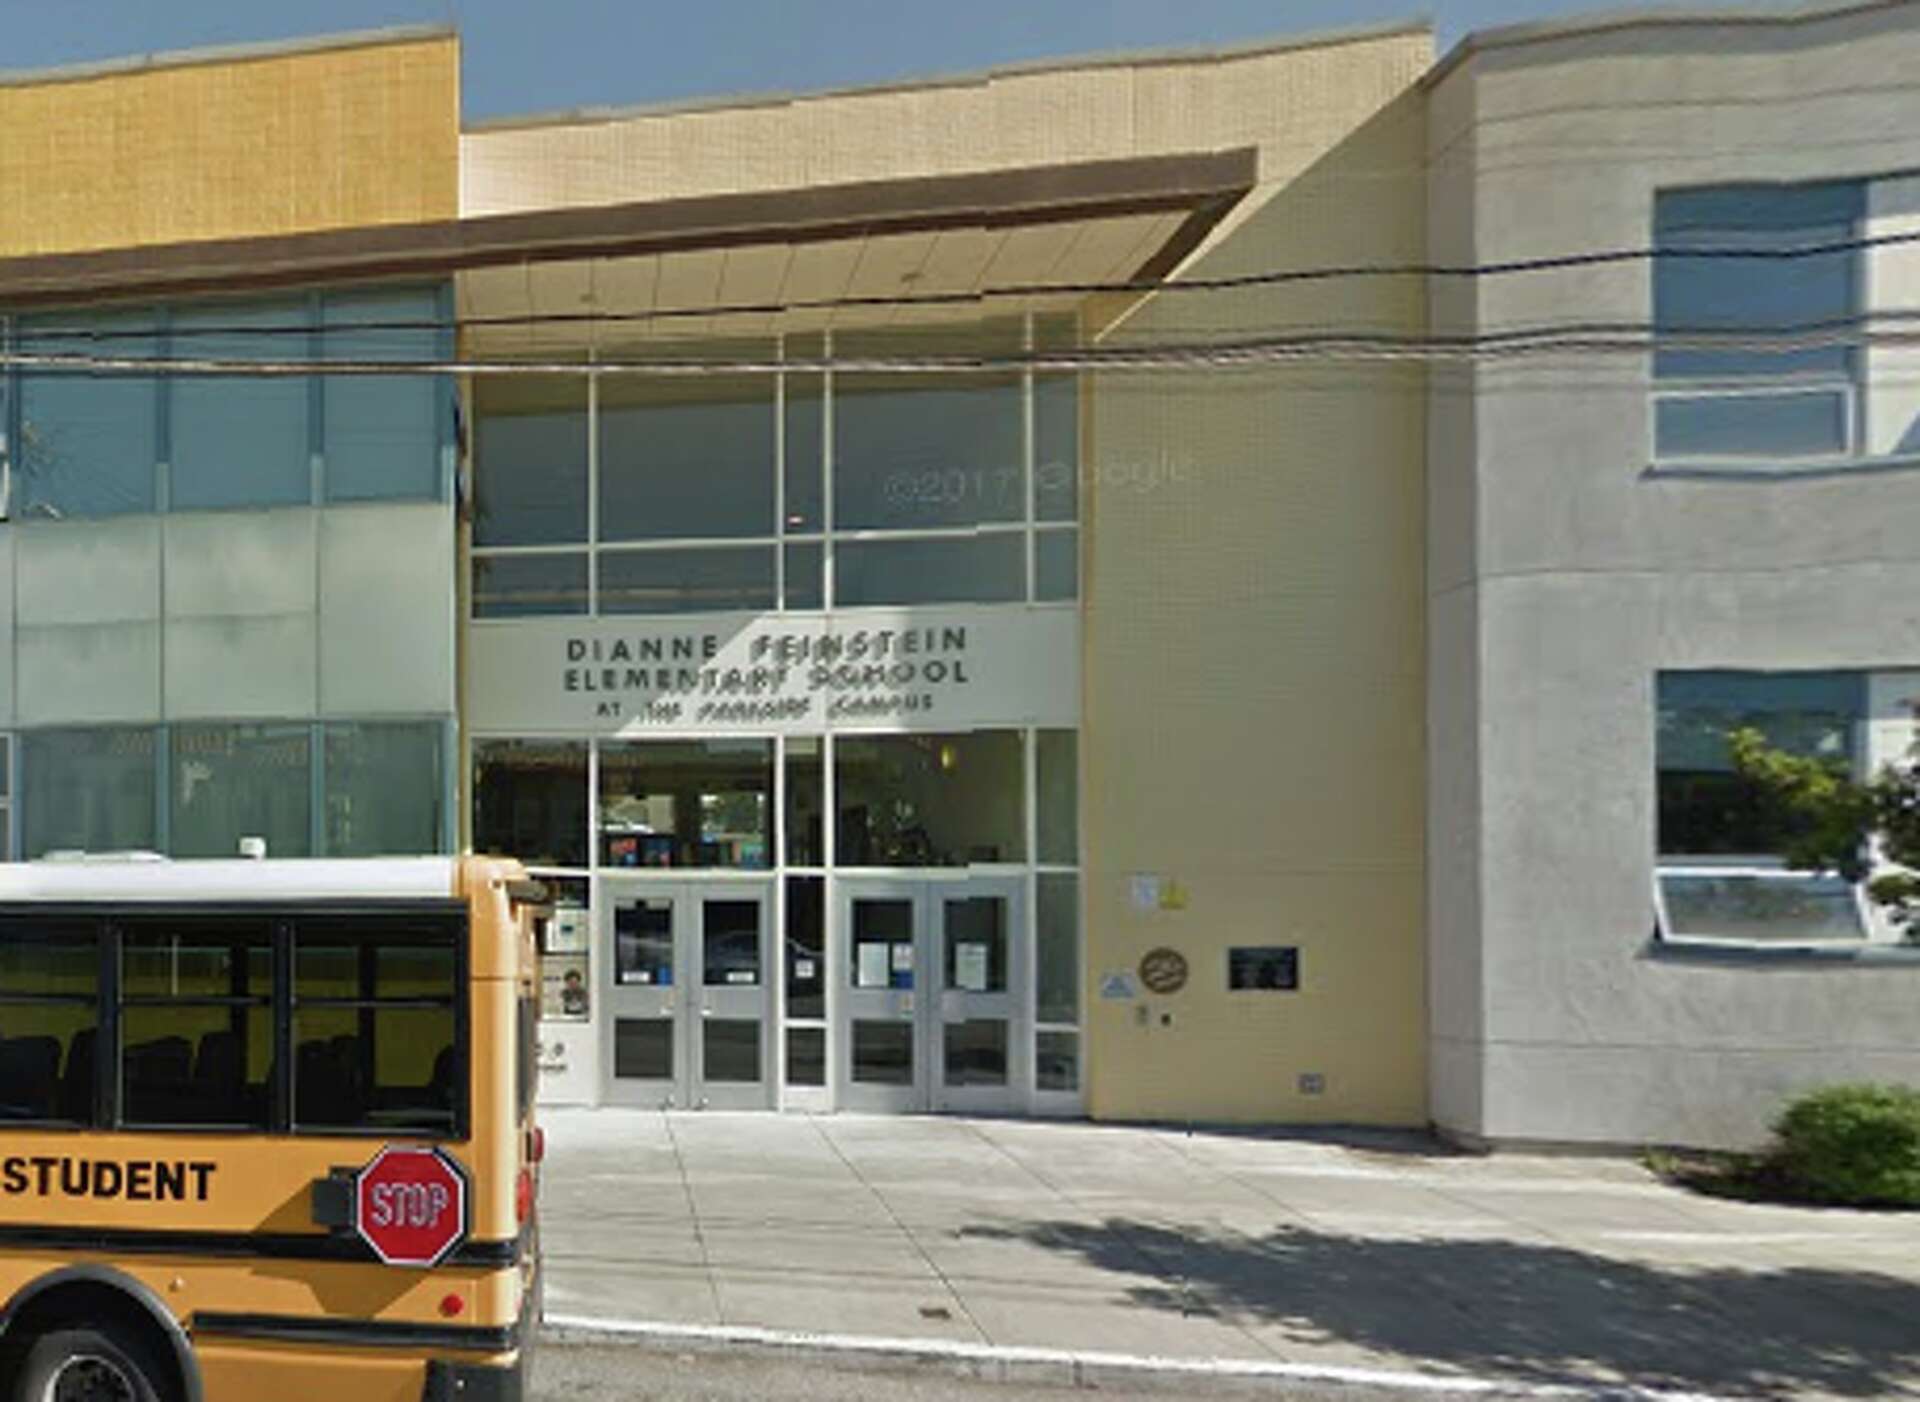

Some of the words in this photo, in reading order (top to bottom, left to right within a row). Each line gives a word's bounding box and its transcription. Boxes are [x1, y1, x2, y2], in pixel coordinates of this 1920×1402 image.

[567, 635, 717, 662] DIANNE
[754, 627, 966, 658] FEINSTEIN
[564, 667, 787, 691] ELEMENTARY
[812, 661, 968, 685] SCHOOL
[597, 702, 621, 716] AT
[834, 694, 932, 713] CAMPUS
[2, 1157, 216, 1201] STUDENT
[369, 1182, 449, 1227] STOP
